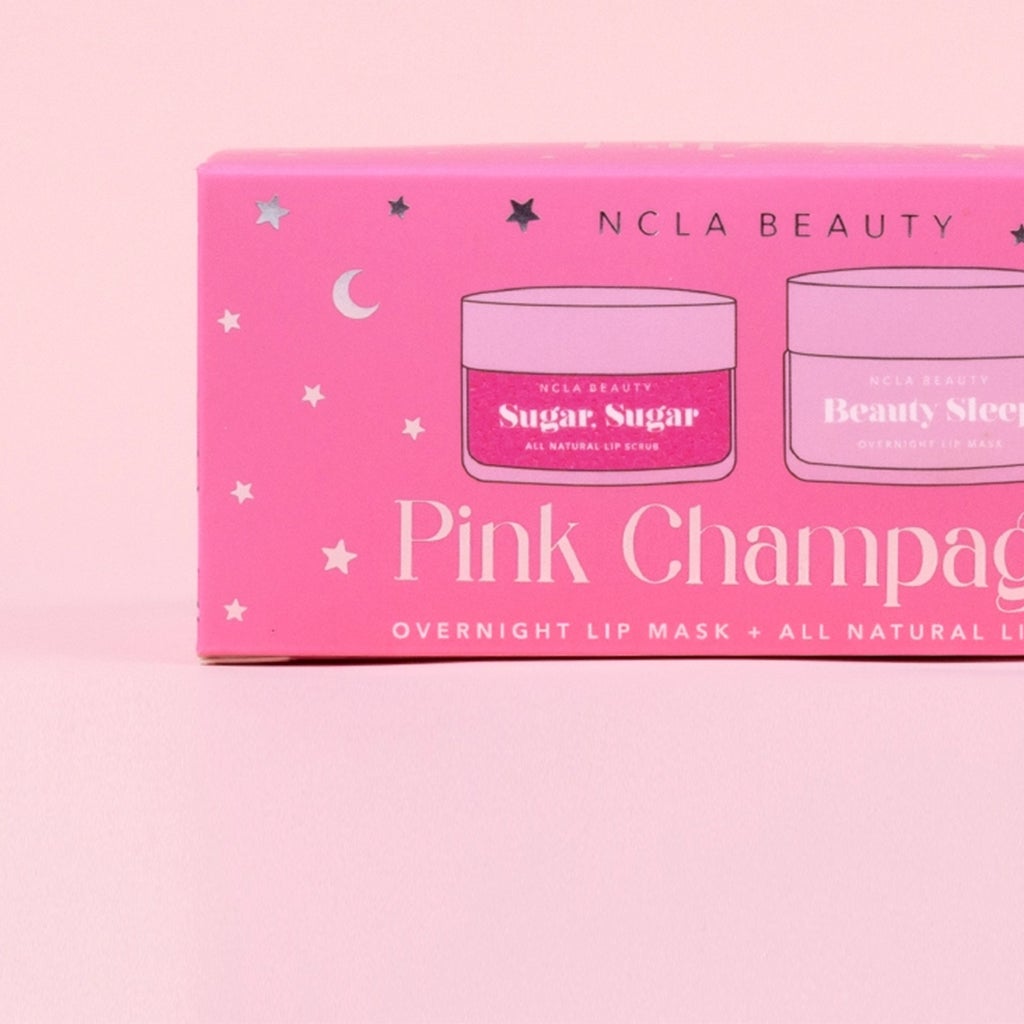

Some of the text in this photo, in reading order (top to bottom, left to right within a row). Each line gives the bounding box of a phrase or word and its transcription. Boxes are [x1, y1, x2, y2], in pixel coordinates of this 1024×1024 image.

[599, 210, 953, 239] NCLA BEAUTY
[539, 383, 652, 393] NCLA BEAUTY
[869, 376, 989, 386] NCLA BEAUTY
[604, 403, 700, 433] Sugar
[823, 397, 938, 429] Beauty
[525, 442, 660, 451] ALL NATURAL LIP SCRUB
[857, 439, 1004, 449] OVERNIGHT LIP MASK
[394, 499, 590, 584] Pink
[392, 622, 570, 640] OVERNIGHT
[587, 623, 631, 640] LIP
[649, 623, 730, 640] MASK
[778, 624, 830, 641] ALL
[847, 623, 985, 641] NATURAL
